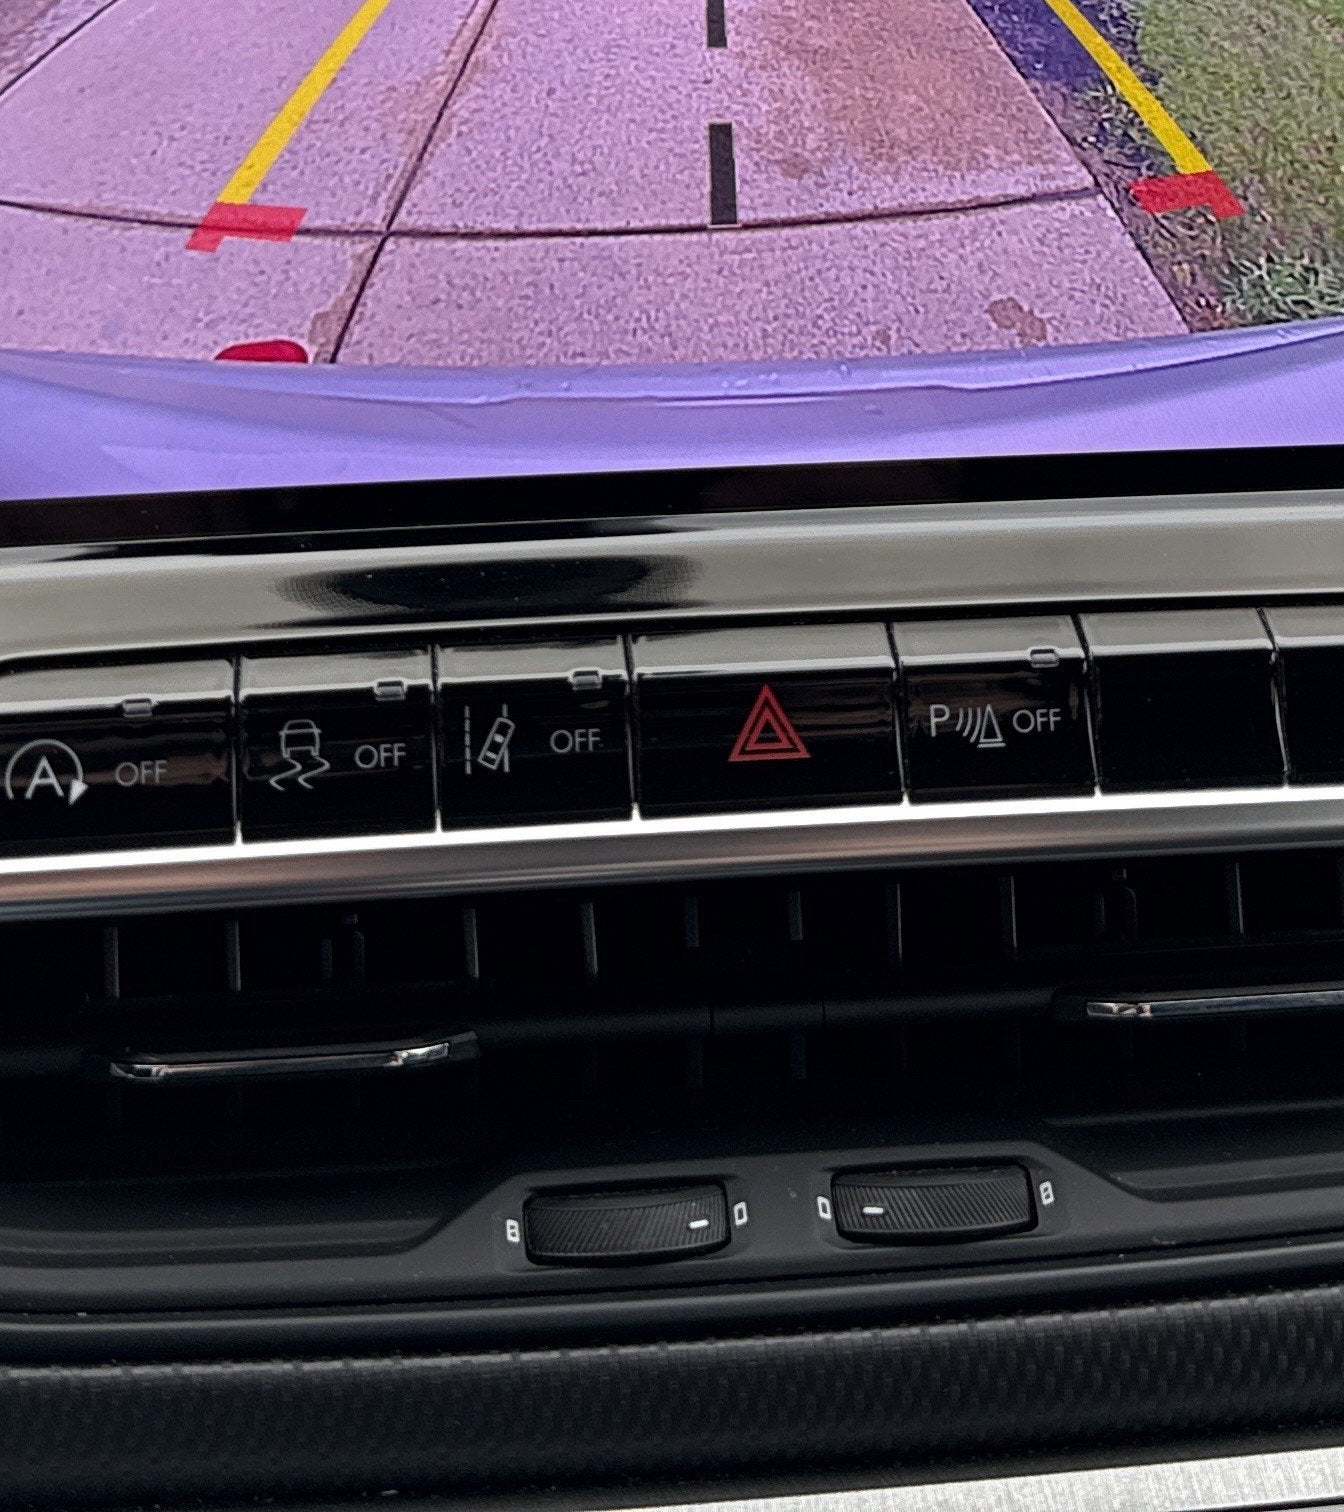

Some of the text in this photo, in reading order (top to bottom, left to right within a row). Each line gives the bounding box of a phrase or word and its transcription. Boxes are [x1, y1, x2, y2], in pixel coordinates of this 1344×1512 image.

[1012, 708, 1062, 734] OFF
[549, 728, 602, 754] OFF
[354, 742, 407, 769] OFF
[115, 759, 168, 787] OFF
